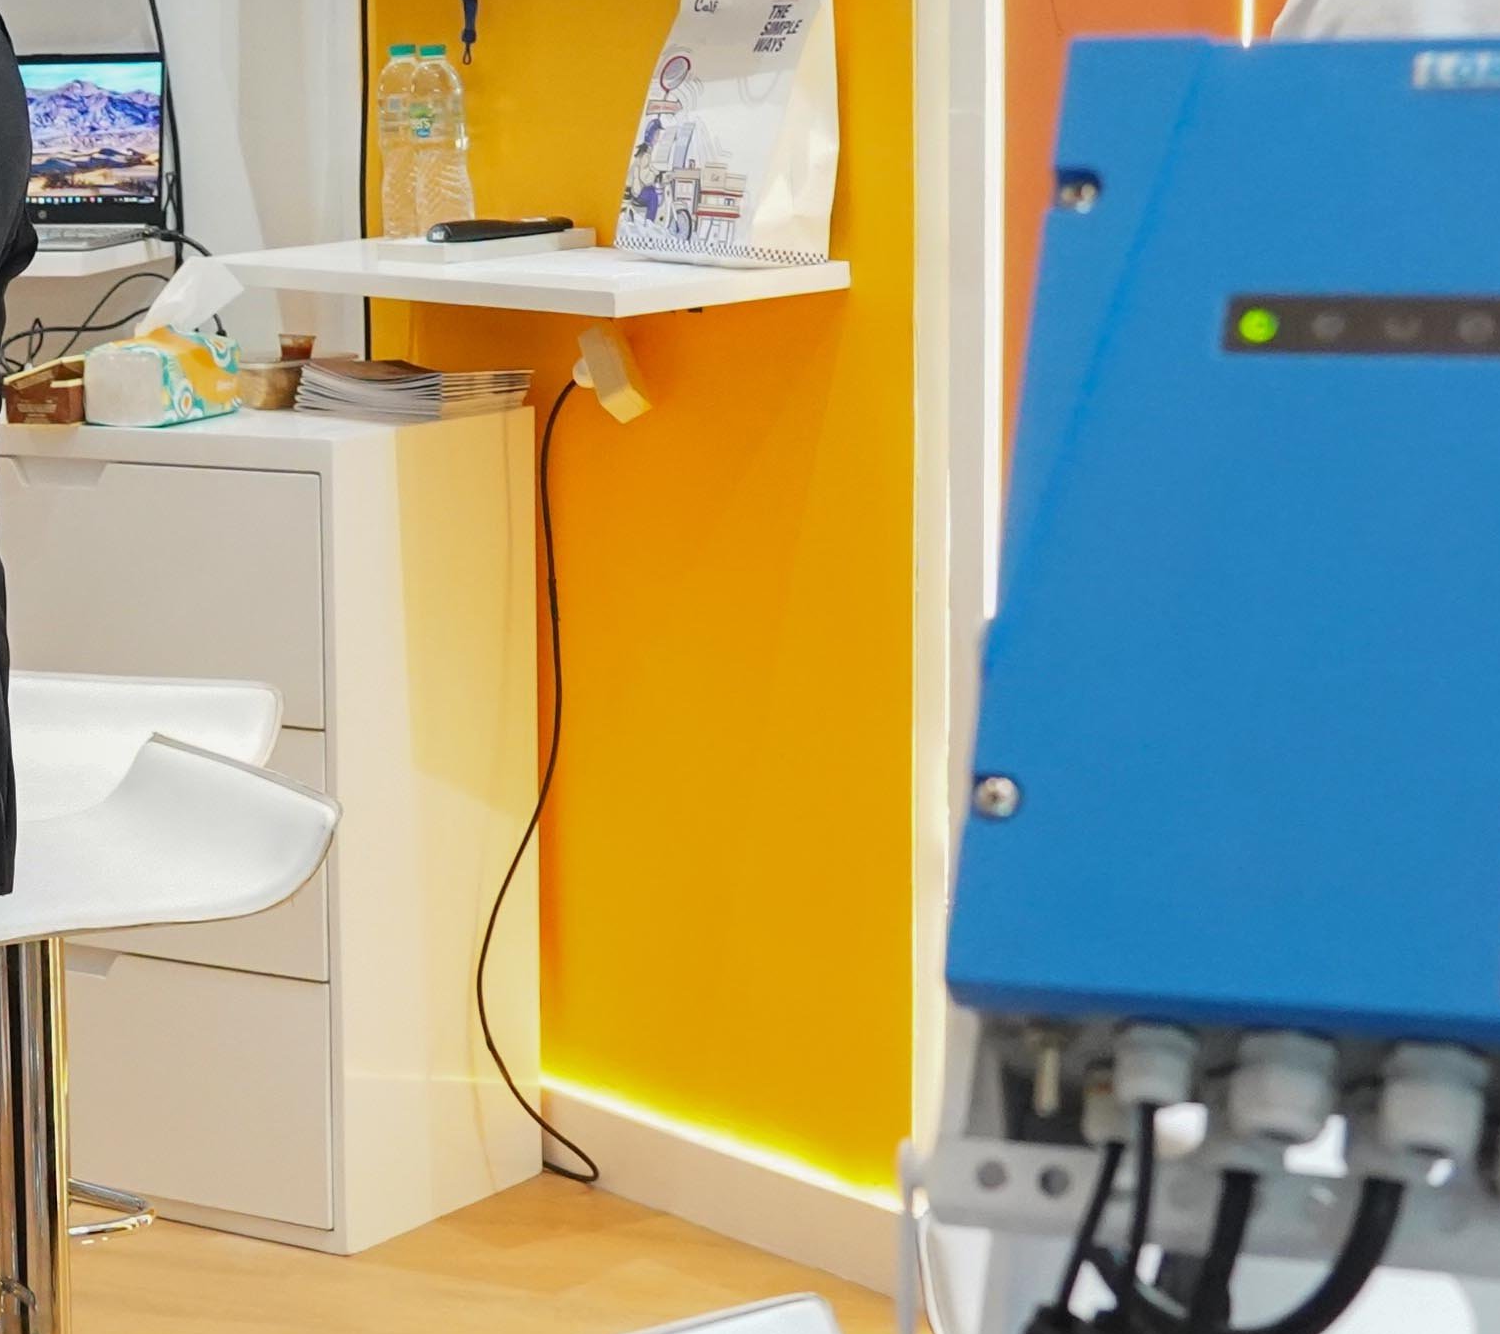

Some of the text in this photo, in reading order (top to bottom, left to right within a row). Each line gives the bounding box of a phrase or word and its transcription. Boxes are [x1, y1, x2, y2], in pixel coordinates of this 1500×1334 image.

[769, 3, 793, 20] THE
[760, 19, 803, 36] SIMPLE
[753, 37, 786, 53] WAYS
